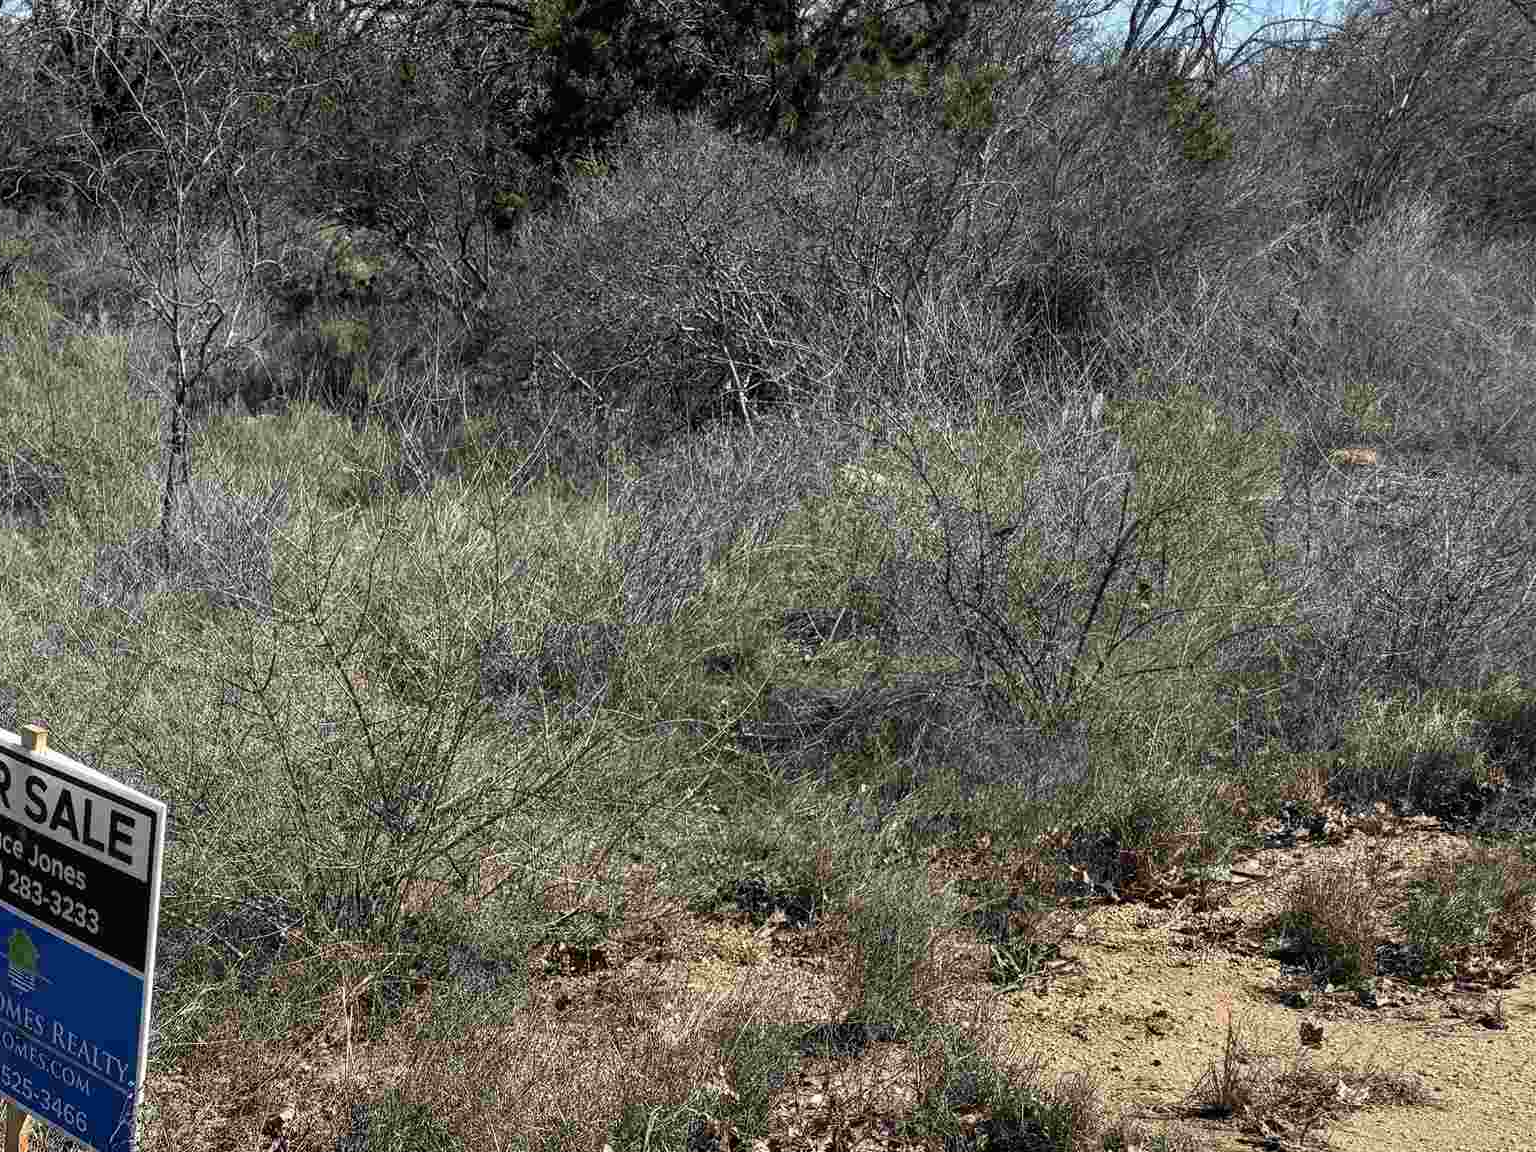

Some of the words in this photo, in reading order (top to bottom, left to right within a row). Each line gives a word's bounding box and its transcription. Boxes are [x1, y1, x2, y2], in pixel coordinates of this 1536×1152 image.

[23, 775, 136, 866] SALE
[28, 845, 87, 891] Jones
[8, 872, 100, 935] 283-3233
[1, 1064, 88, 1133] 525-3466
